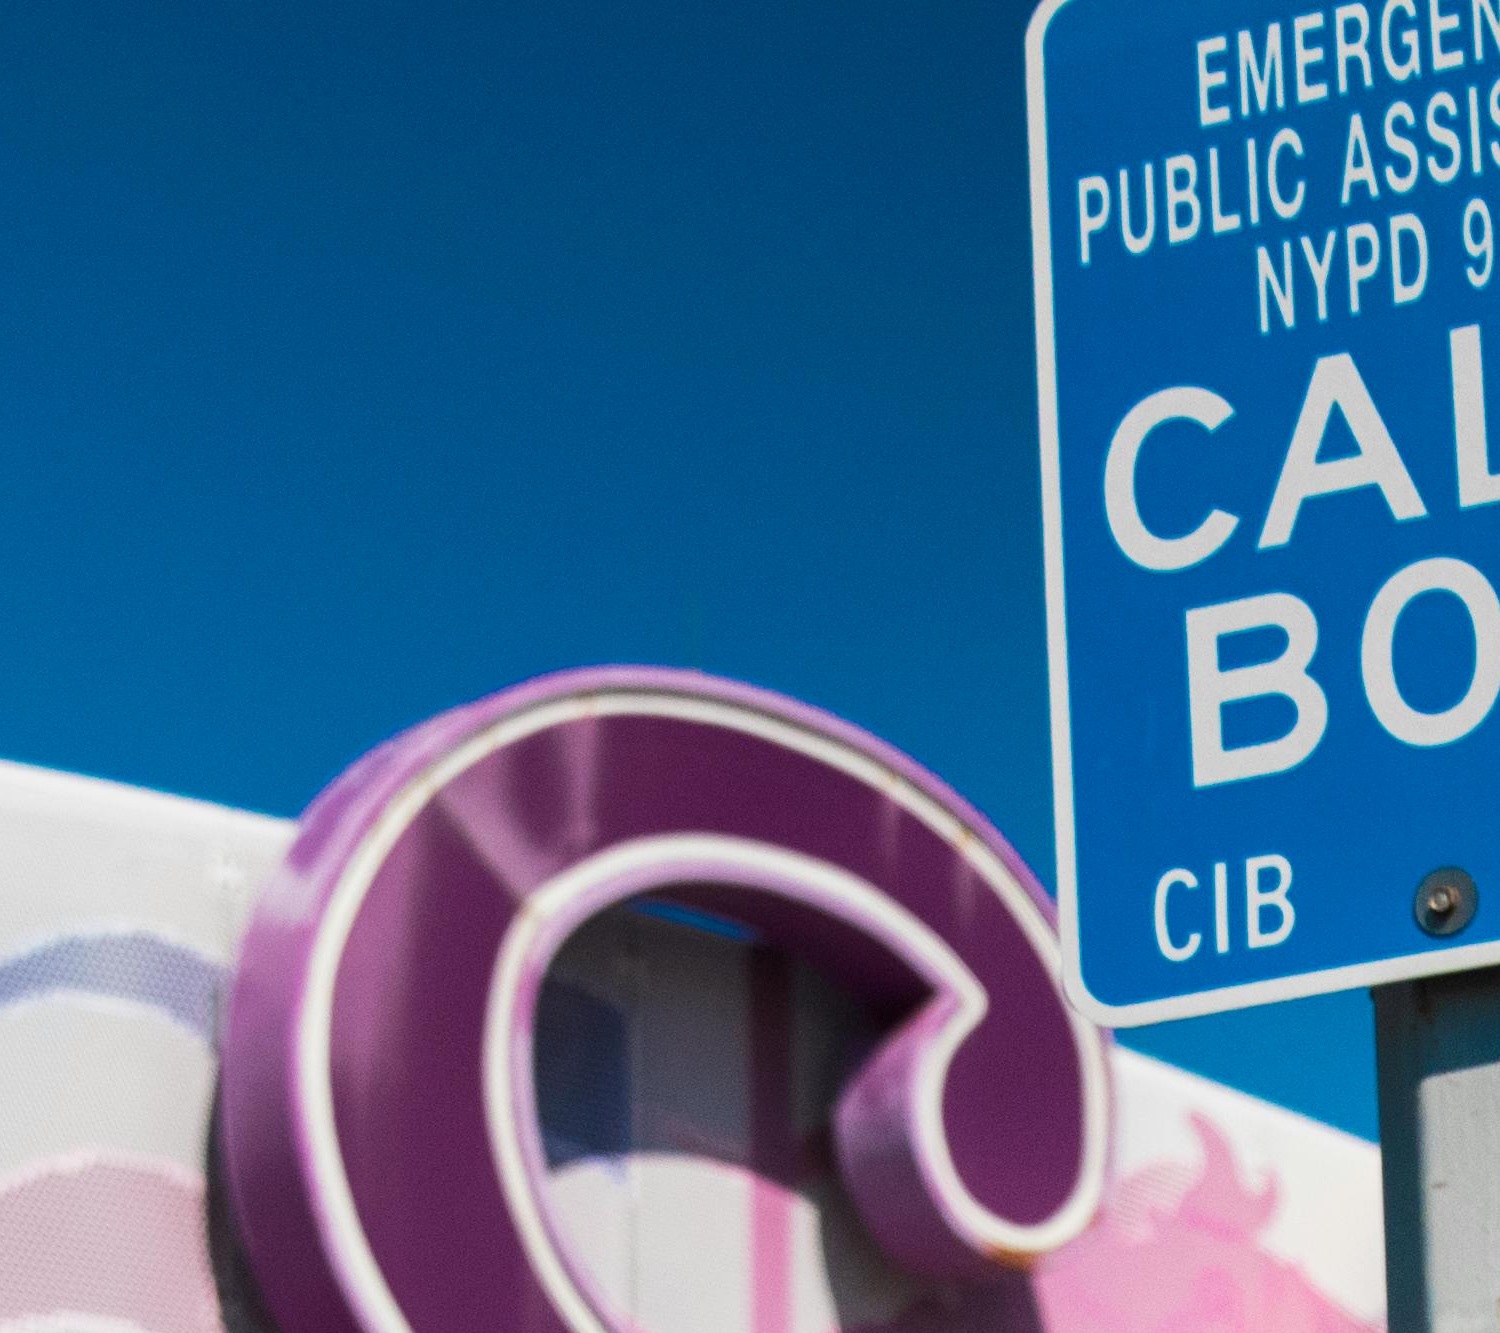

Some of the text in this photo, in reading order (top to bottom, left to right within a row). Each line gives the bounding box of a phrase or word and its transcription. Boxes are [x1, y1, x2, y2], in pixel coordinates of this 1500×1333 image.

[1077, 127, 1306, 264] PUBLIC
[1256, 212, 1429, 333] NYPD
[1153, 853, 1296, 962] CIB
